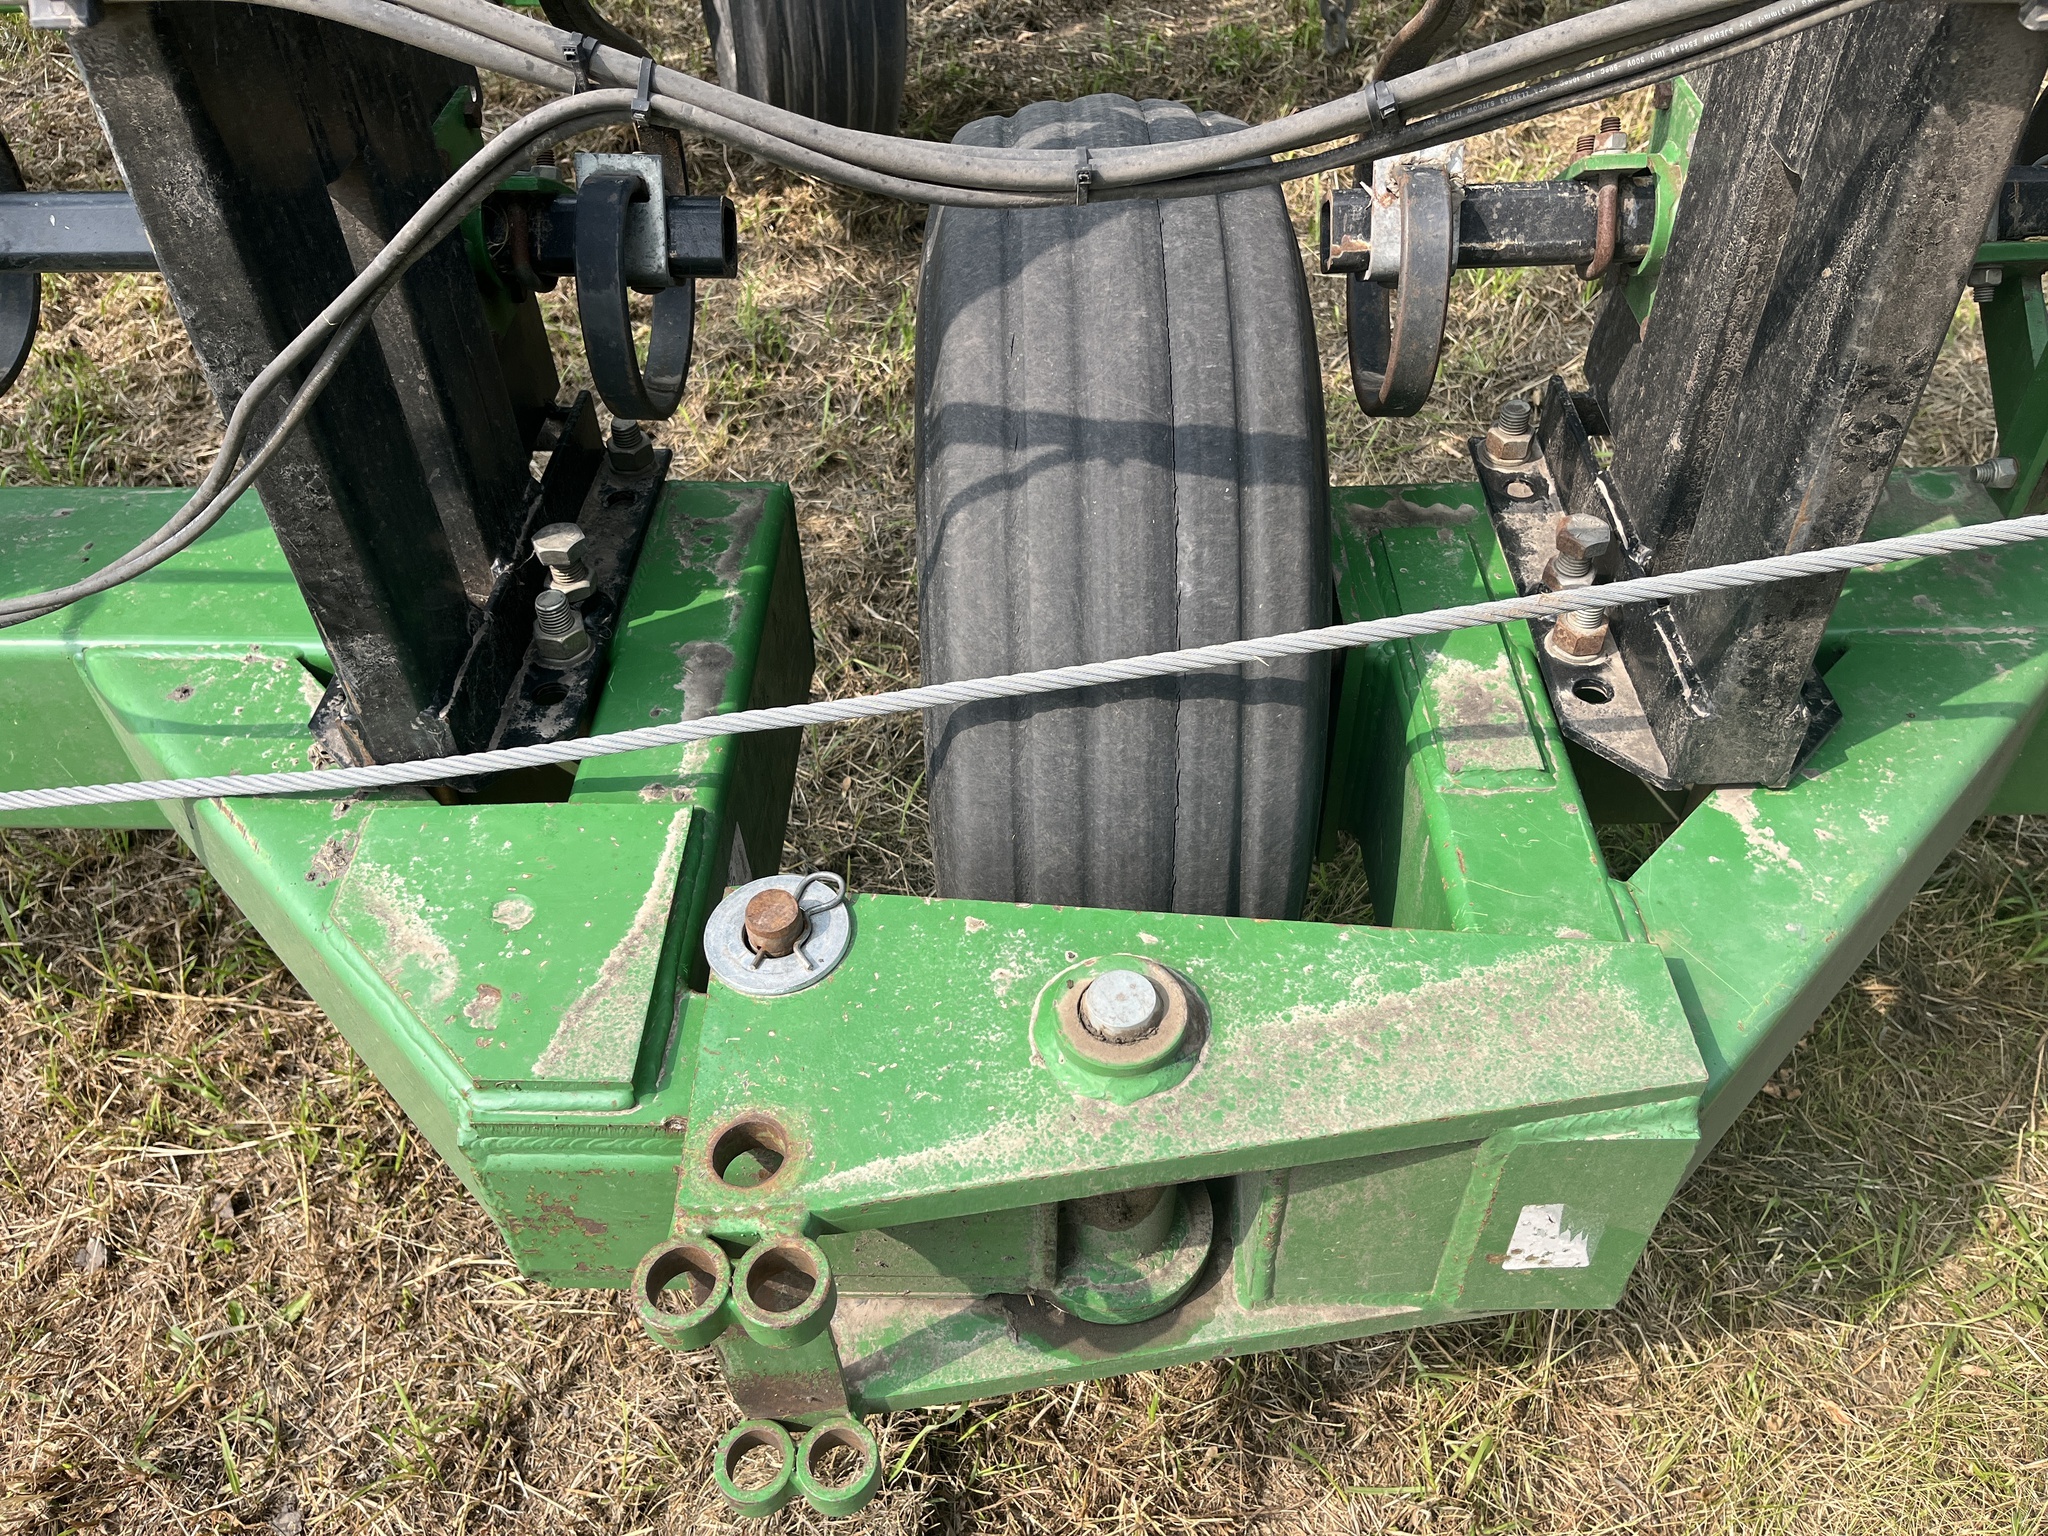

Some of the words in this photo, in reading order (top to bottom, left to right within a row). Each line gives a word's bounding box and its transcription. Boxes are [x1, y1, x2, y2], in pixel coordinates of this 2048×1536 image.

[1739, 20, 1753, 30] 3/C
[1703, 27, 1734, 43] SJEOOW
[1650, 50, 1665, 60] (UL)
[1627, 56, 1645, 68] 300V
